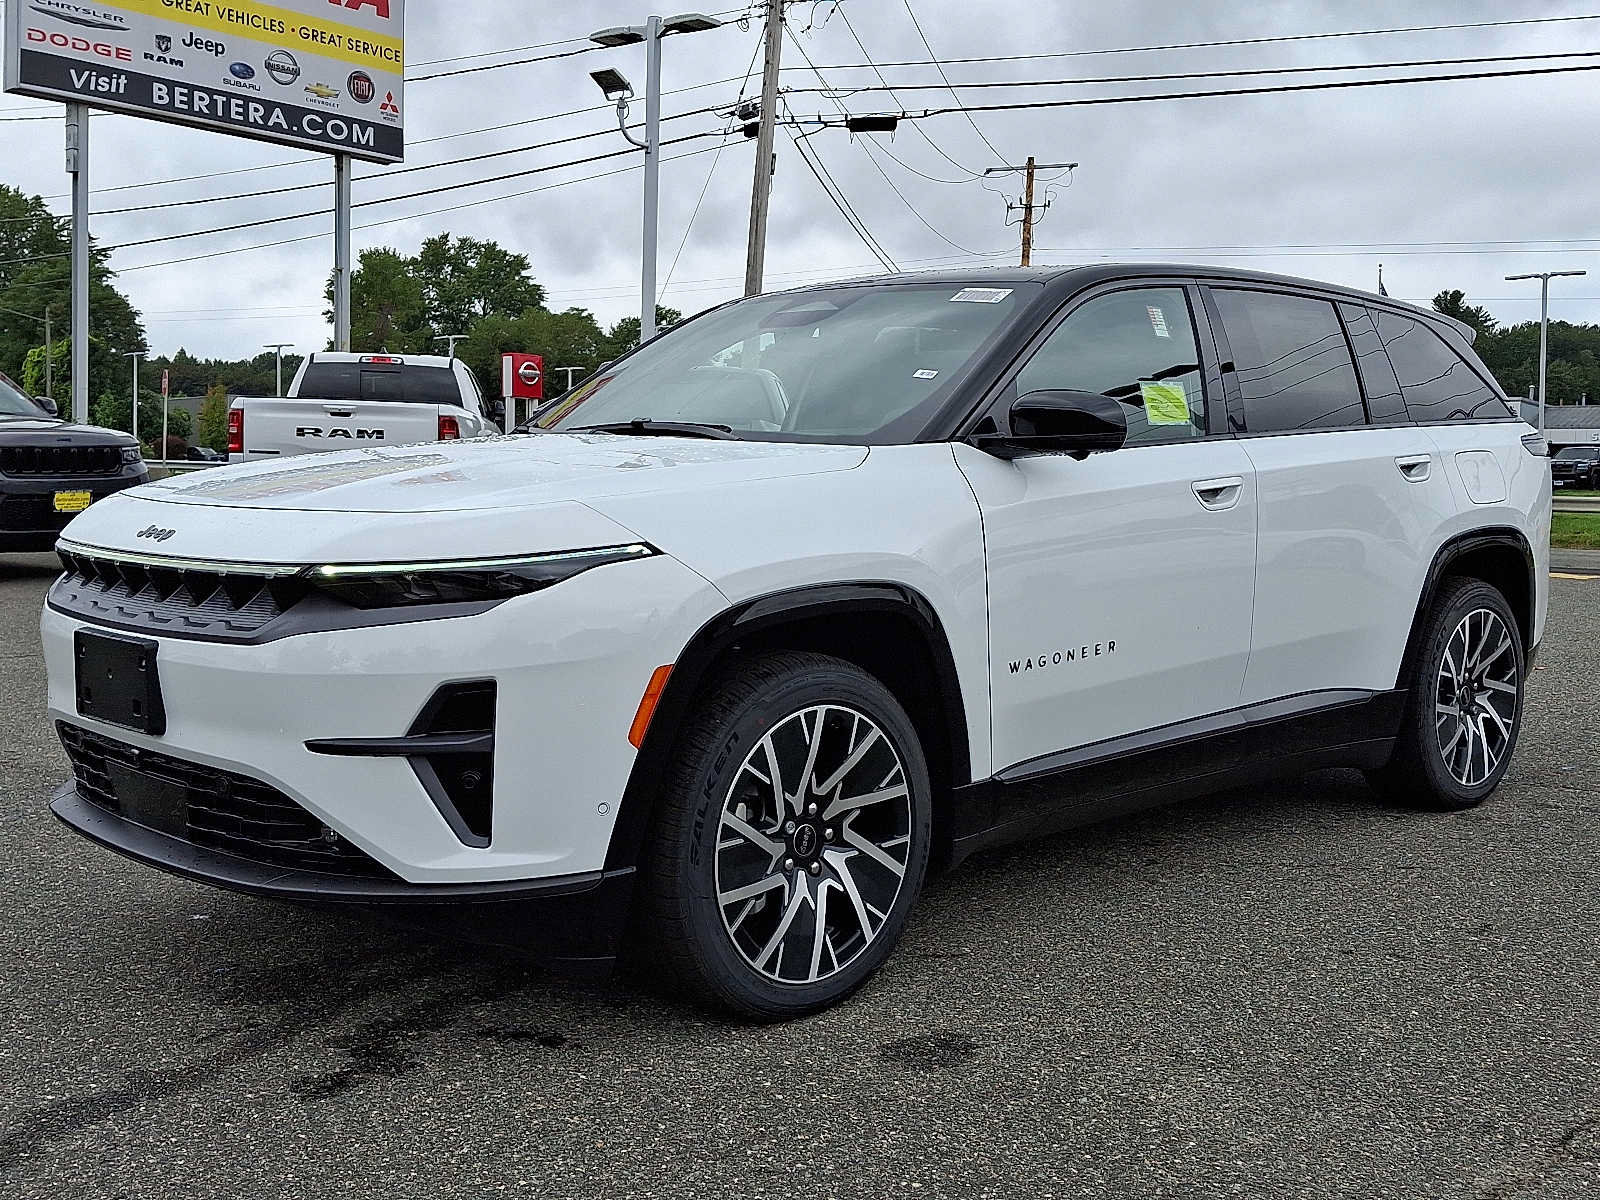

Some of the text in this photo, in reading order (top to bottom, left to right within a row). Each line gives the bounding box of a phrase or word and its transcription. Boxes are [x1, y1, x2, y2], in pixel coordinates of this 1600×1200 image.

[216, 5, 285, 34] VEHICLES
[298, 26, 343, 48] GREAT
[347, 38, 401, 63] SERVICE
[27, 28, 133, 62] DODGE
[181, 31, 226, 57] Jeep
[143, 52, 184, 68] RAM
[267, 61, 298, 74] NISSAN
[222, 78, 261, 91] SUBARU
[353, 80, 370, 97] FIAT
[69, 69, 375, 147] Visit BERTERA.COM
[305, 97, 340, 109] CHEVROLET
[295, 427, 385, 440] RAM
[136, 524, 176, 542] Jeep
[1008, 640, 1116, 674] WAGONEER
